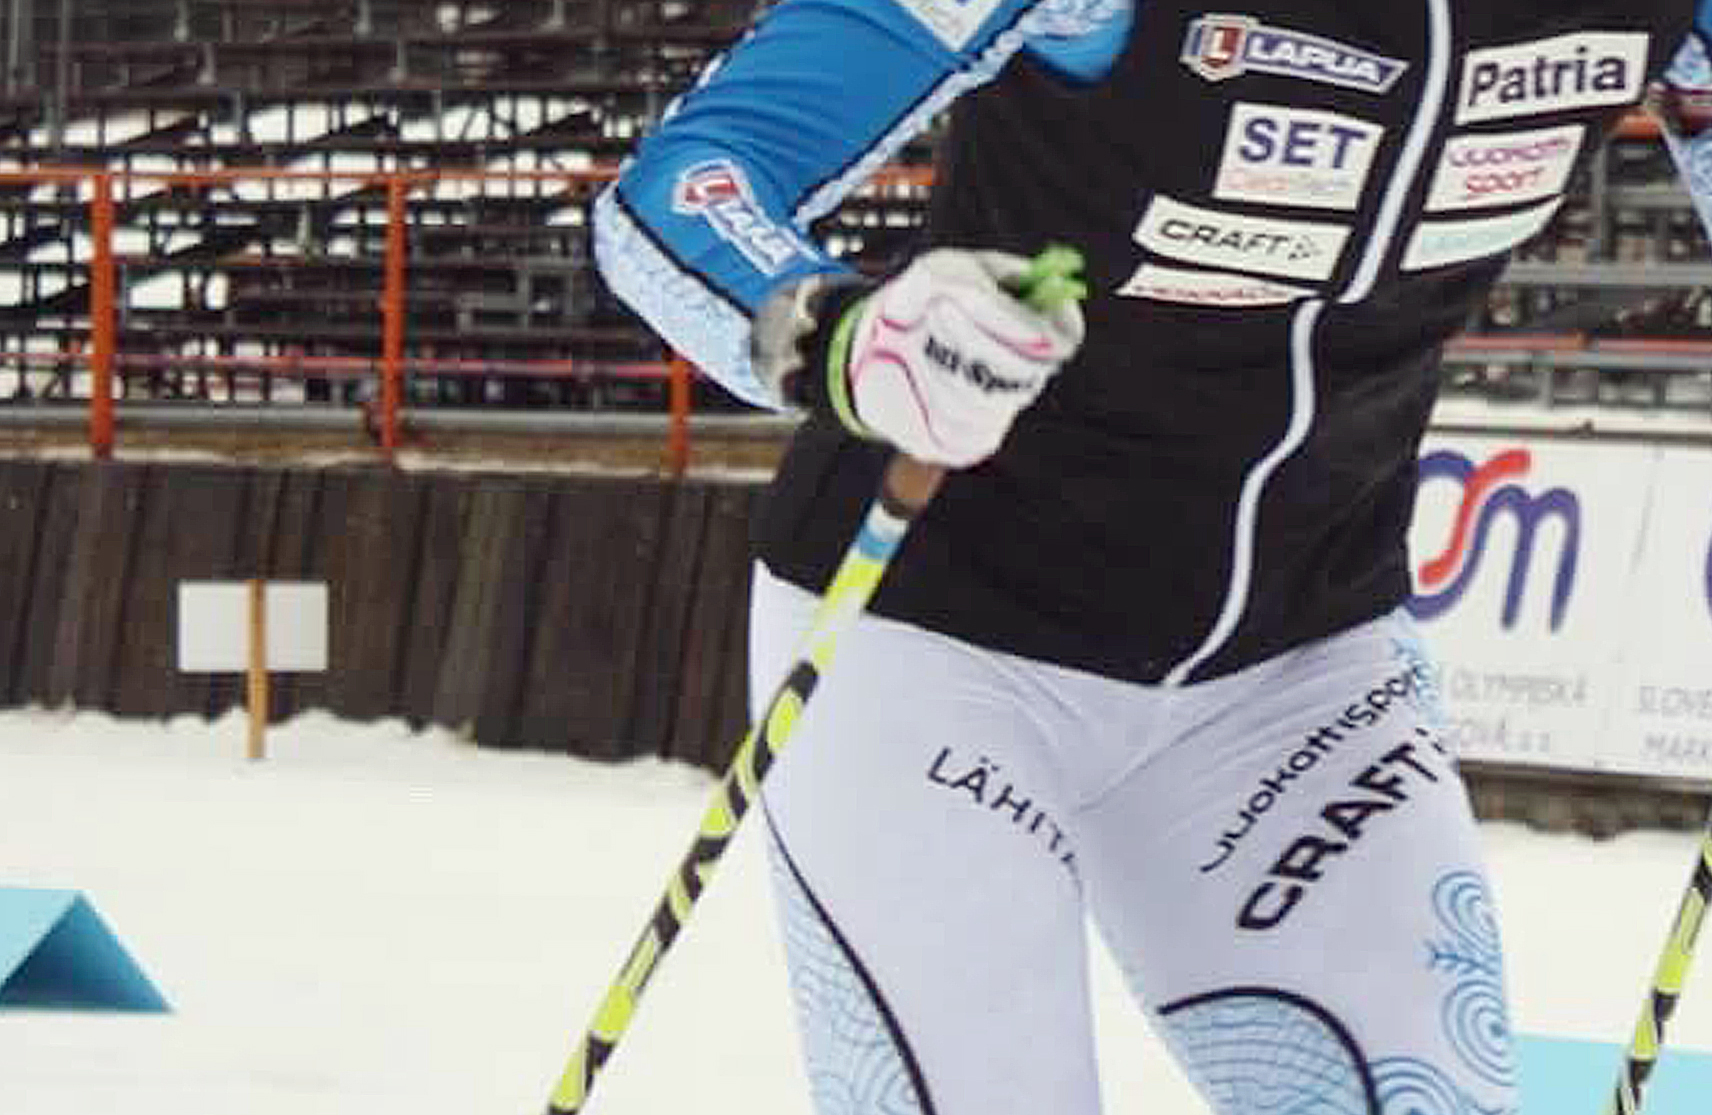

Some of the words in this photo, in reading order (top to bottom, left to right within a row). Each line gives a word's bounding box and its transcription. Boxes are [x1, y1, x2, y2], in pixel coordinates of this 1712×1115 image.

[1250, 35, 1382, 85] LAPUA
[1467, 45, 1628, 108] Patria
[1239, 117, 1367, 169] SET
[1160, 218, 1290, 255] CRAFT
[1236, 742, 1439, 931] CRAFT
